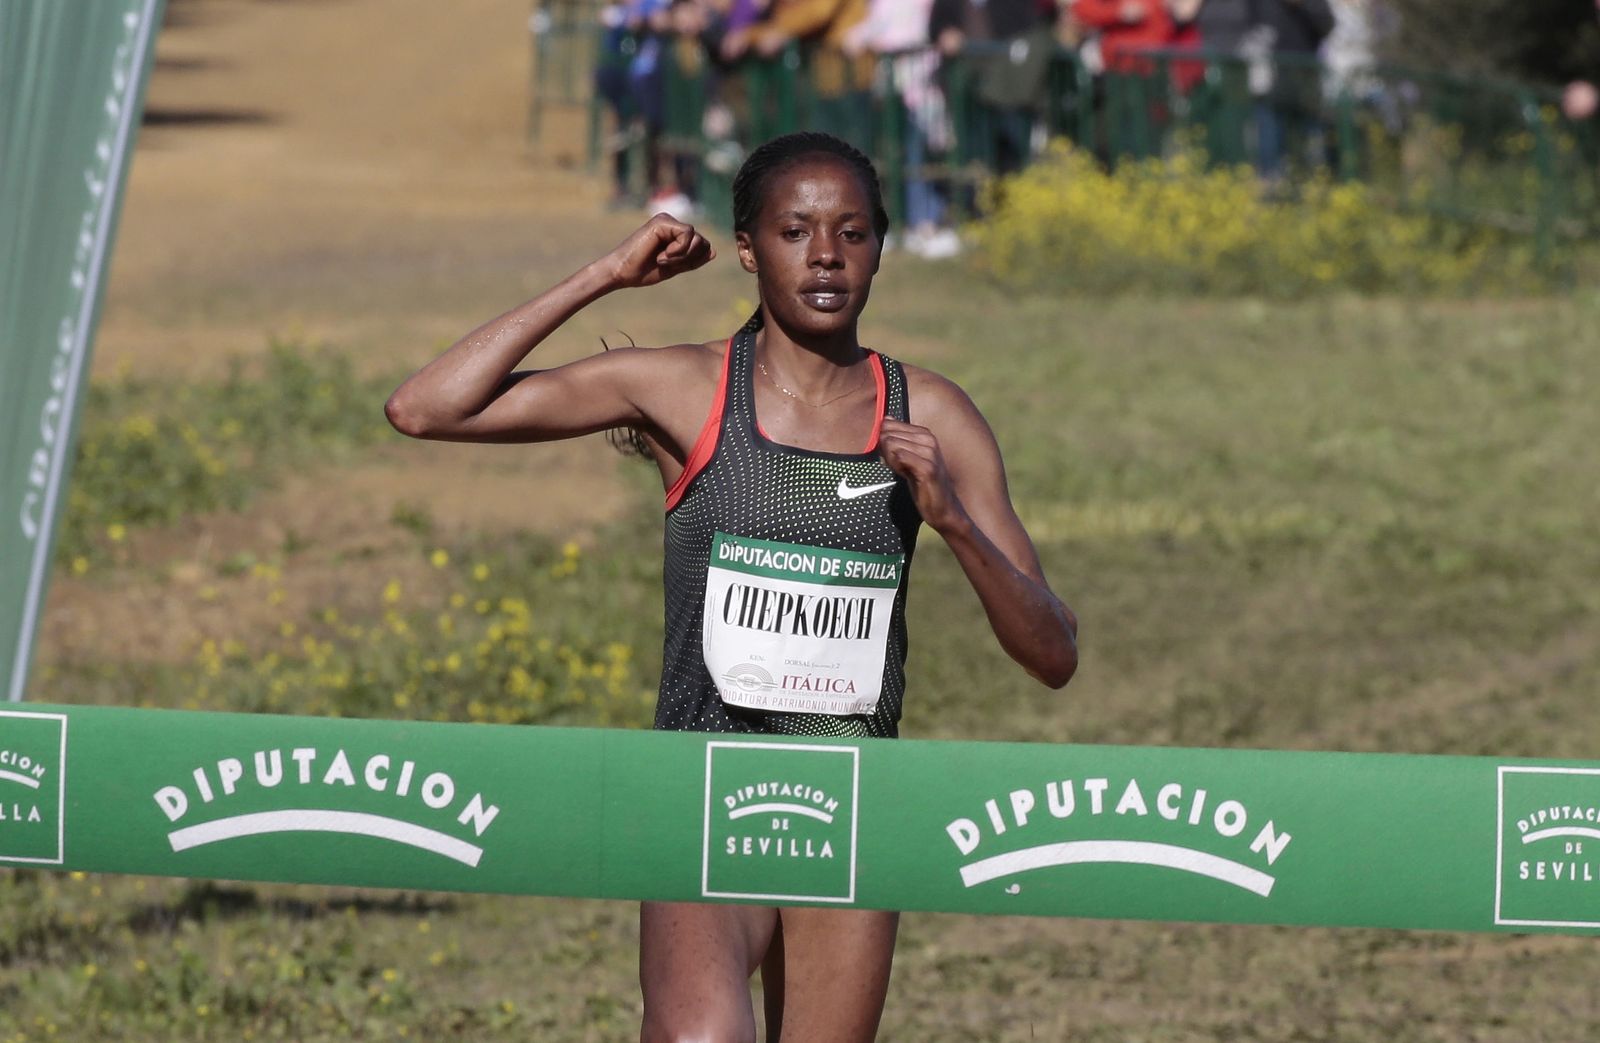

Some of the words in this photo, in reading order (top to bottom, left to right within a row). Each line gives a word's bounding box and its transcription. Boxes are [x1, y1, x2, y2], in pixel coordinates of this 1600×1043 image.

[719, 542, 815, 575] DIPUTACION
[819, 558, 840, 577] DE
[844, 562, 897, 581] SEVILLA
[722, 582, 876, 641] CHEPKOECH
[781, 673, 857, 695] ITÁLICA
[720, 689, 769, 707] DIDATURA
[771, 696, 827, 712] PATRIMONIO
[153, 747, 500, 837] DIPUTACION
[724, 782, 839, 813] DIPUTACION
[773, 818, 789, 831] DE
[945, 777, 1292, 866] DIPUTACION
[726, 836, 834, 858] SEVILLA
[1565, 841, 1583, 855] DE
[1519, 860, 1600, 881] SEVIL
